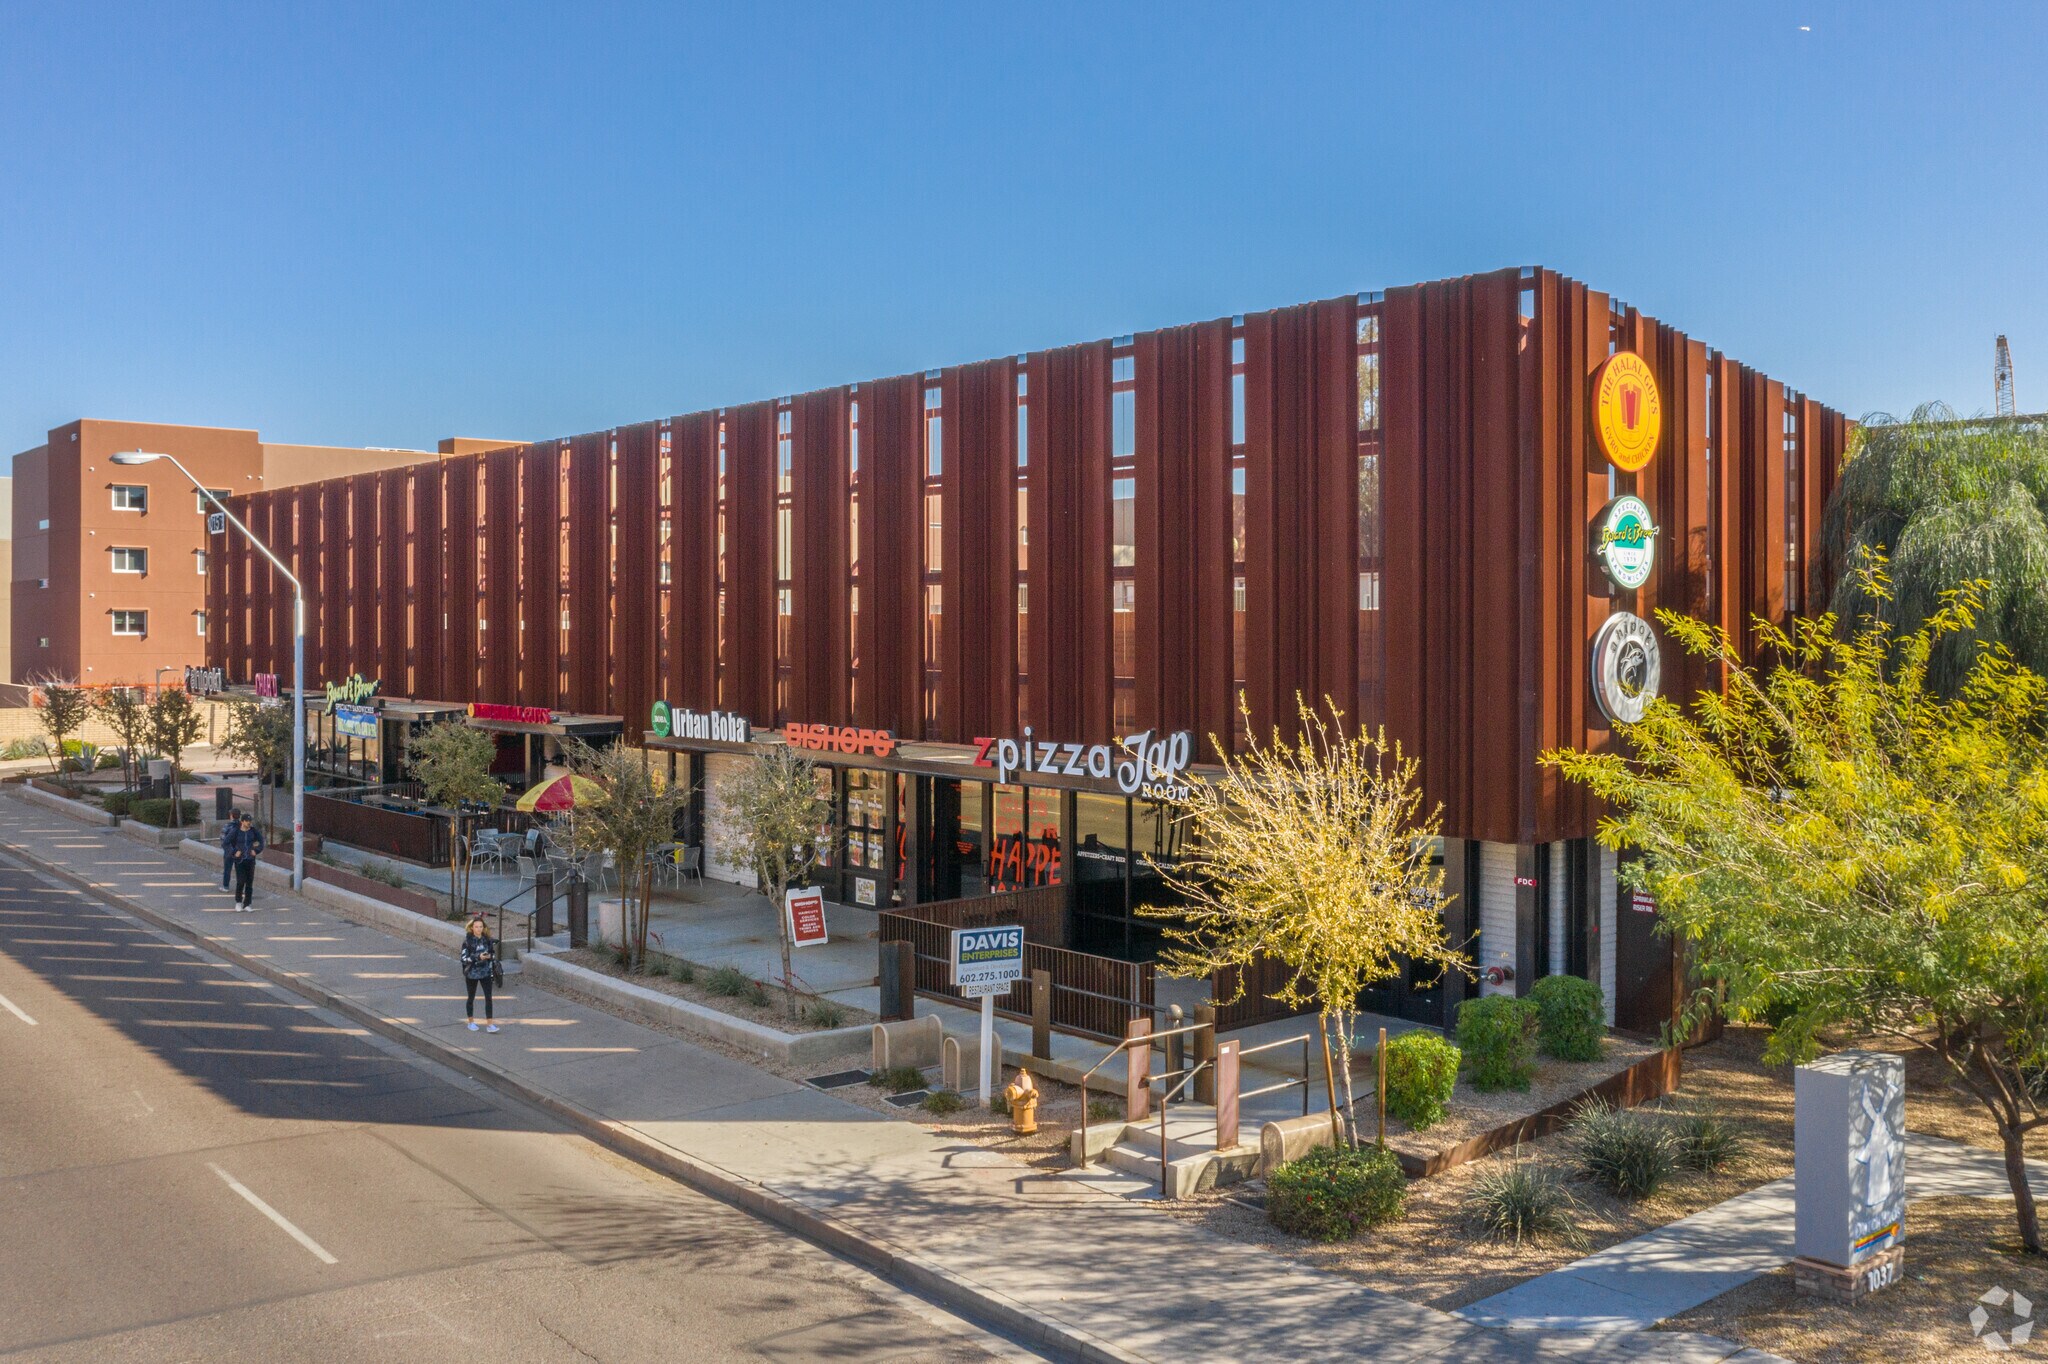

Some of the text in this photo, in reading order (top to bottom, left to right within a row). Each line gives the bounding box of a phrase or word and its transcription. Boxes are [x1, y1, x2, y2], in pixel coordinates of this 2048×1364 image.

[1601, 357, 1658, 415] THE HALAL GUYS
[1605, 426, 1655, 464] GYRO and CHICKEN
[1614, 502, 1647, 521] SPECIALTY
[1611, 557, 1648, 581] SANDWICHES
[1610, 621, 1656, 653] ahipoki
[672, 707, 710, 740] Urban
[711, 710, 747, 743] Boba
[783, 722, 895, 757] BISHOPS
[1142, 782, 1190, 801] ROOM
[996, 815, 1058, 839] COOR
[1517, 877, 1533, 886] FDC
[962, 931, 1019, 951] DAVIS
[961, 947, 1019, 961] ENTERPRISES
[960, 969, 1020, 984] 602.275.1000
[1868, 1262, 1893, 1292] 1037
